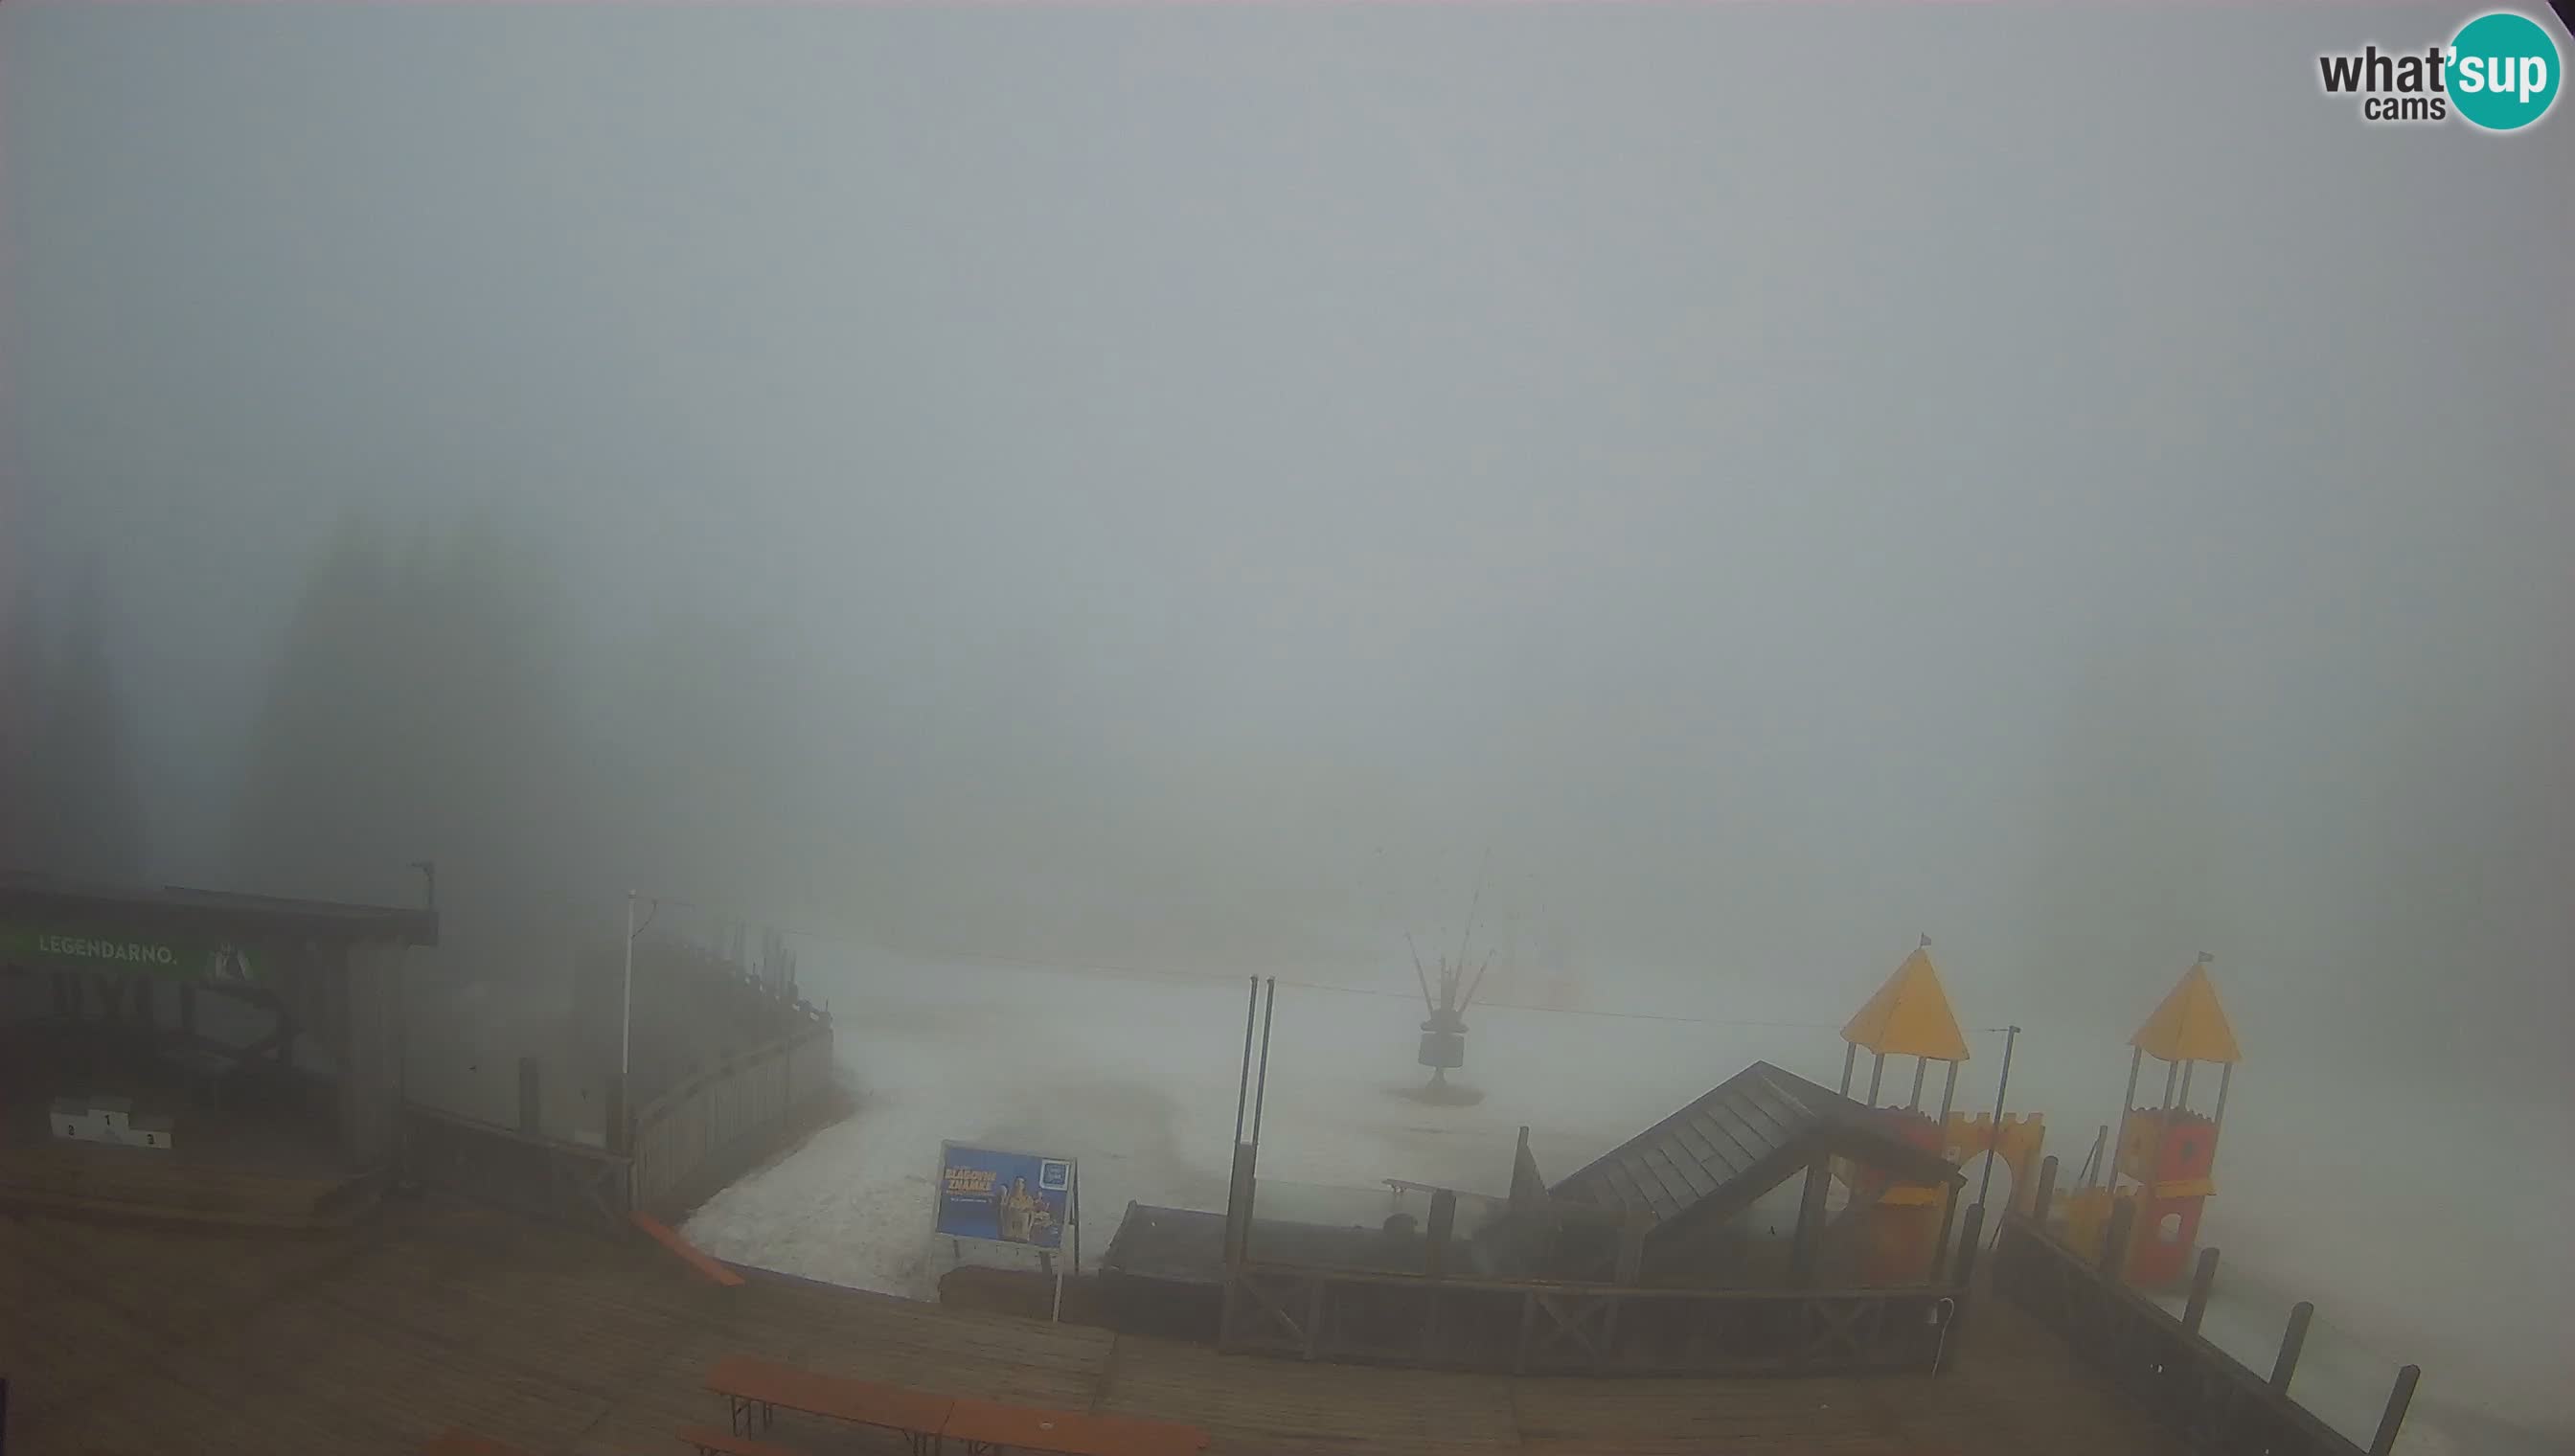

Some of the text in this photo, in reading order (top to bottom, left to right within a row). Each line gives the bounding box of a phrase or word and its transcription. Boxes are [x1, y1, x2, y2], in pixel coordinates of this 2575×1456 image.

[39, 934, 177, 965] LEGENDARNO.
[104, 1114, 111, 1126] 1
[68, 1125, 75, 1136] 2
